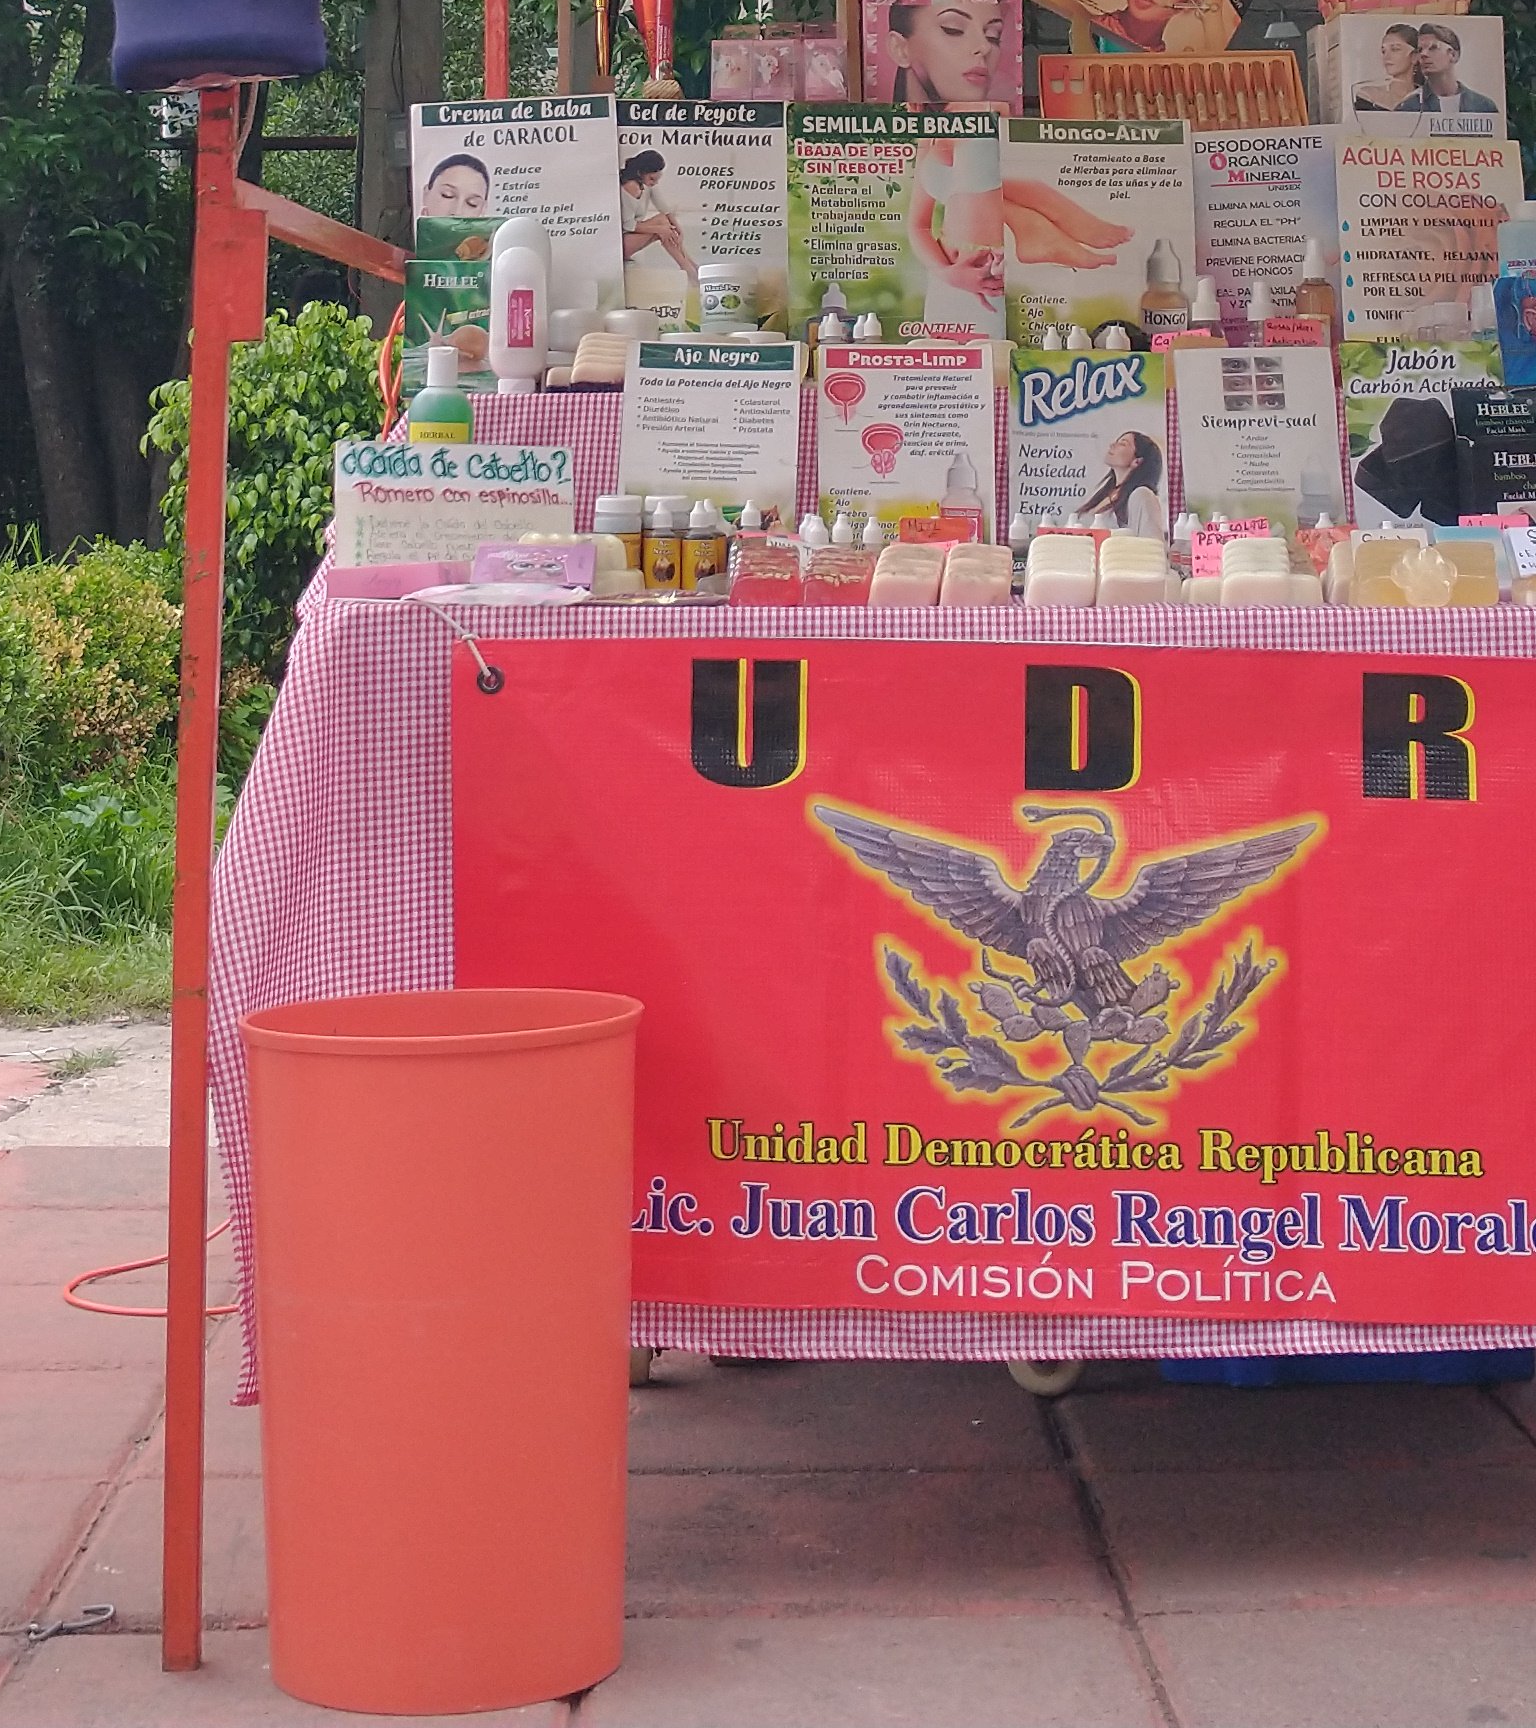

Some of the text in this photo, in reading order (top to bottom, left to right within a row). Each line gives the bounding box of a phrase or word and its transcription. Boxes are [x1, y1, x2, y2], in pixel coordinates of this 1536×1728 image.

[439, 100, 592, 123] Crema de Baba
[629, 103, 757, 124] Gel de Peyote
[803, 116, 996, 134] SEMILLA DE BRASIL
[1430, 118, 1493, 132] FACE SHIELD
[464, 125, 578, 148] de CARACOL
[619, 129, 773, 148] con Marihuana
[1194, 136, 1322, 153] DESODORANTE
[848, 145, 868, 157] DE
[874, 145, 913, 157] PESO
[1342, 147, 1504, 167] AGUA MICELAR
[1073, 154, 1165, 163] Tratamiento Base
[1210, 152, 1298, 170] ORGANICO
[494, 165, 542, 175] Reduce
[677, 166, 734, 176] DOLORES
[806, 159, 904, 174] SIN REBOTE!
[1112, 167, 1135, 177] para
[1136, 166, 1177, 176] eliminar
[1227, 169, 1301, 184] MINERAL
[1377, 171, 1481, 189] DE ROSAS
[700, 180, 776, 191] PROFUNDOS
[1058, 178, 1093, 189] hongos
[1267, 183, 1301, 192] UNISEX
[811, 185, 872, 195] Acelera el
[811, 198, 886, 209] Metabolismo
[1208, 199, 1301, 211] ELIMINA MAL OLOR
[1359, 194, 1497, 209] CON COLAGENO
[502, 203, 574, 215] Aclara piel
[714, 203, 780, 213] Muscular
[557, 213, 610, 225] Expresión
[711, 217, 783, 228] De Huesos
[879, 212, 901, 221] con
[1360, 218, 1408, 227] LIMPIAR
[1213, 218, 1272, 229] REGULA EL
[569, 226, 598, 236] Solar
[710, 231, 761, 241] Artritis
[1361, 228, 1405, 237] LA PIEL
[710, 245, 761, 256] Varices
[810, 239, 853, 250] Elimina
[1206, 256, 1253, 267] PREVIENE
[1232, 267, 1294, 277] DE HONGOS
[1363, 273, 1458, 283] REFRESCA LA PIEL
[1363, 287, 1426, 297] POR EL SOL
[1027, 308, 1044, 318] Ajo
[1144, 311, 1186, 325] HONGO
[674, 347, 760, 367] Ajo Negro
[1385, 349, 1456, 375] Jabón
[639, 377, 723, 388] Toda Potencia
[1350, 378, 1414, 394] Carbón
[1022, 357, 1143, 423] Relax
[1477, 403, 1531, 416] HEBLEE
[1201, 413, 1318, 431] Siemprevi-sual
[1018, 444, 1073, 459] Nervios
[1018, 463, 1087, 479] Ansiedad
[352, 481, 435, 504] Romero
[442, 488, 471, 504] con
[1019, 482, 1087, 498] Insomnio
[1019, 500, 1062, 516] Estrés
[691, 658, 1478, 802] U D R
[707, 1118, 1485, 1184] Unidad Democrática Republicana
[732, 1182, 879, 1243] Juan
[895, 1185, 1096, 1248] Carlos
[1112, 1189, 1325, 1265] Rangel
[855, 1251, 1337, 1304] COMISIÓN POLÍTICA
